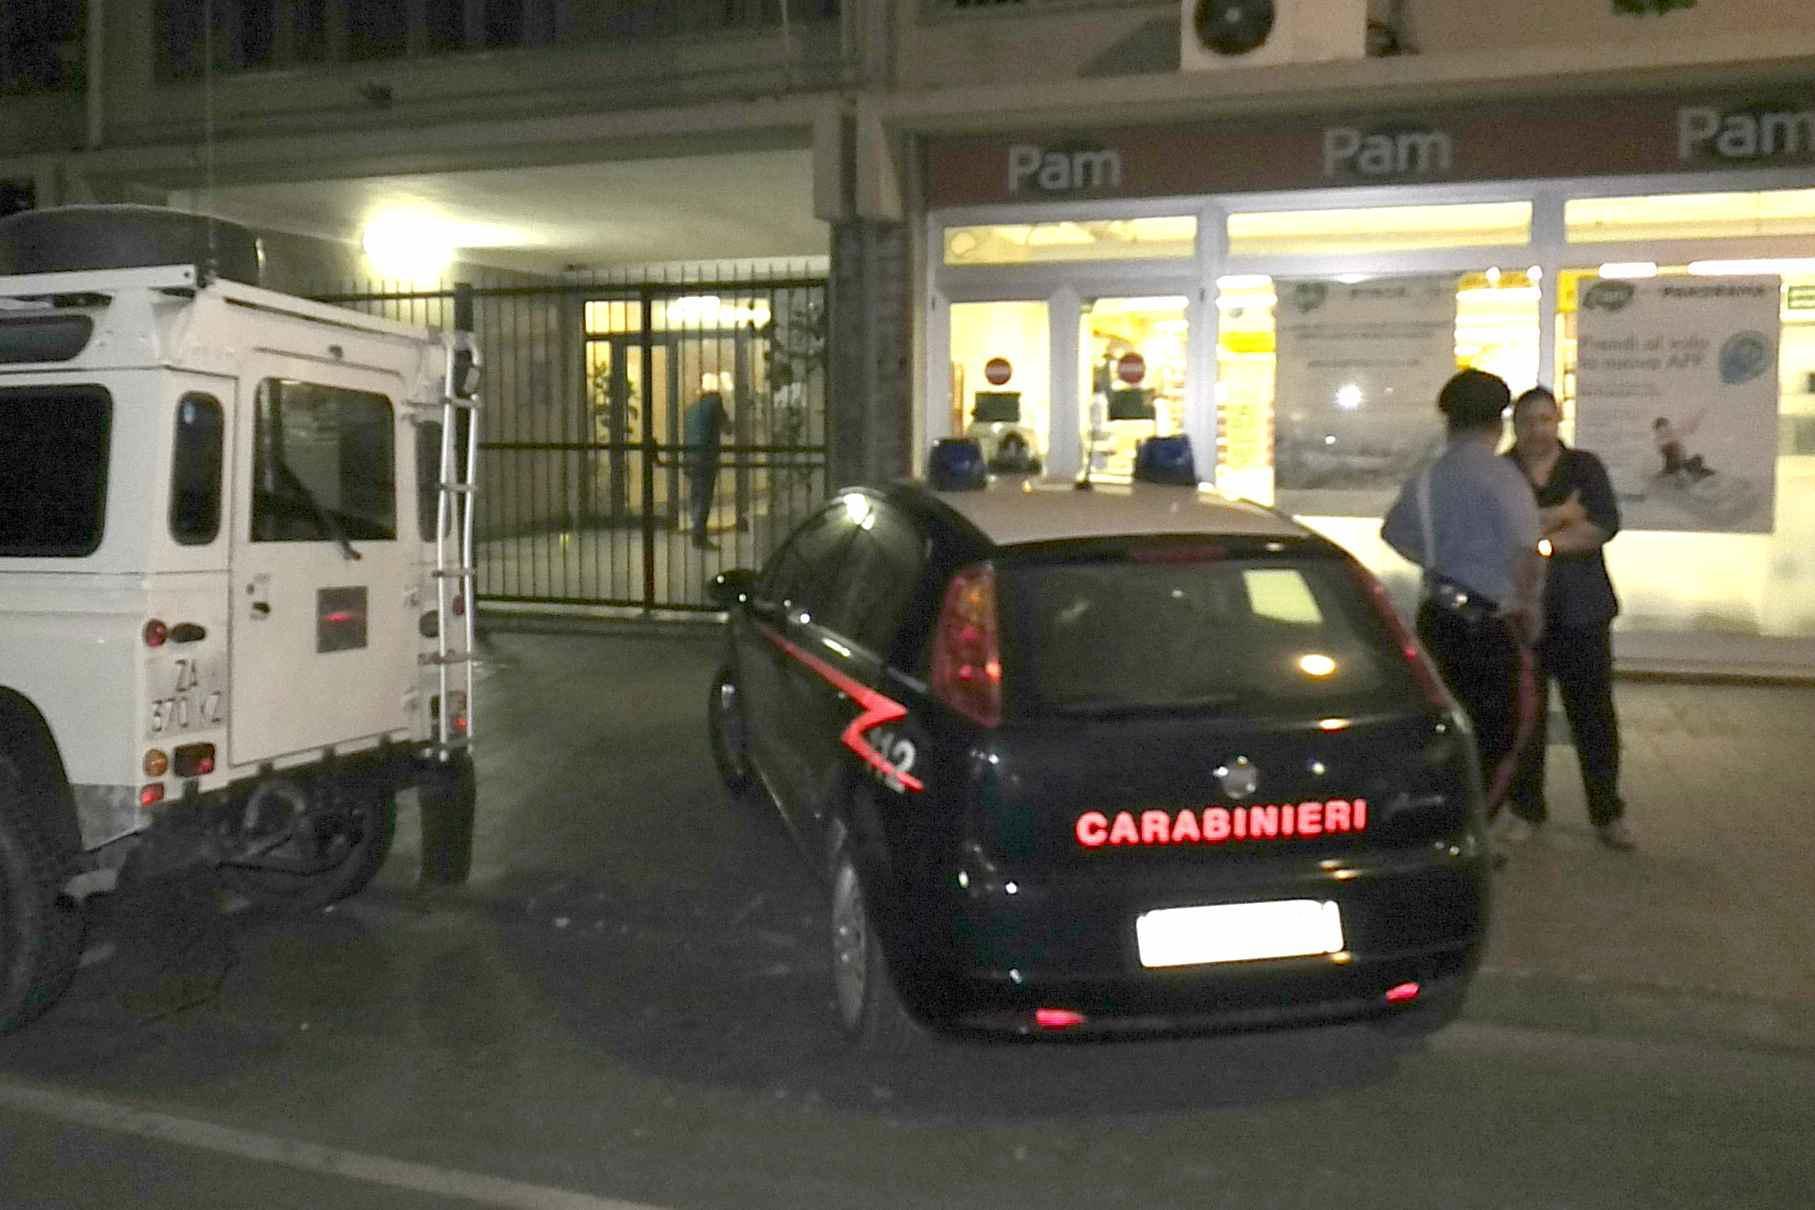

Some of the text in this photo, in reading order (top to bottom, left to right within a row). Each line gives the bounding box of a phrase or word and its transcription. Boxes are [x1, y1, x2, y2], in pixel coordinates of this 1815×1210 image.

[1322, 126, 1452, 178] Pam
[1678, 105, 1815, 160] Pam
[1006, 143, 1122, 193] Pam
[1075, 798, 1368, 848] CARABINIERI
